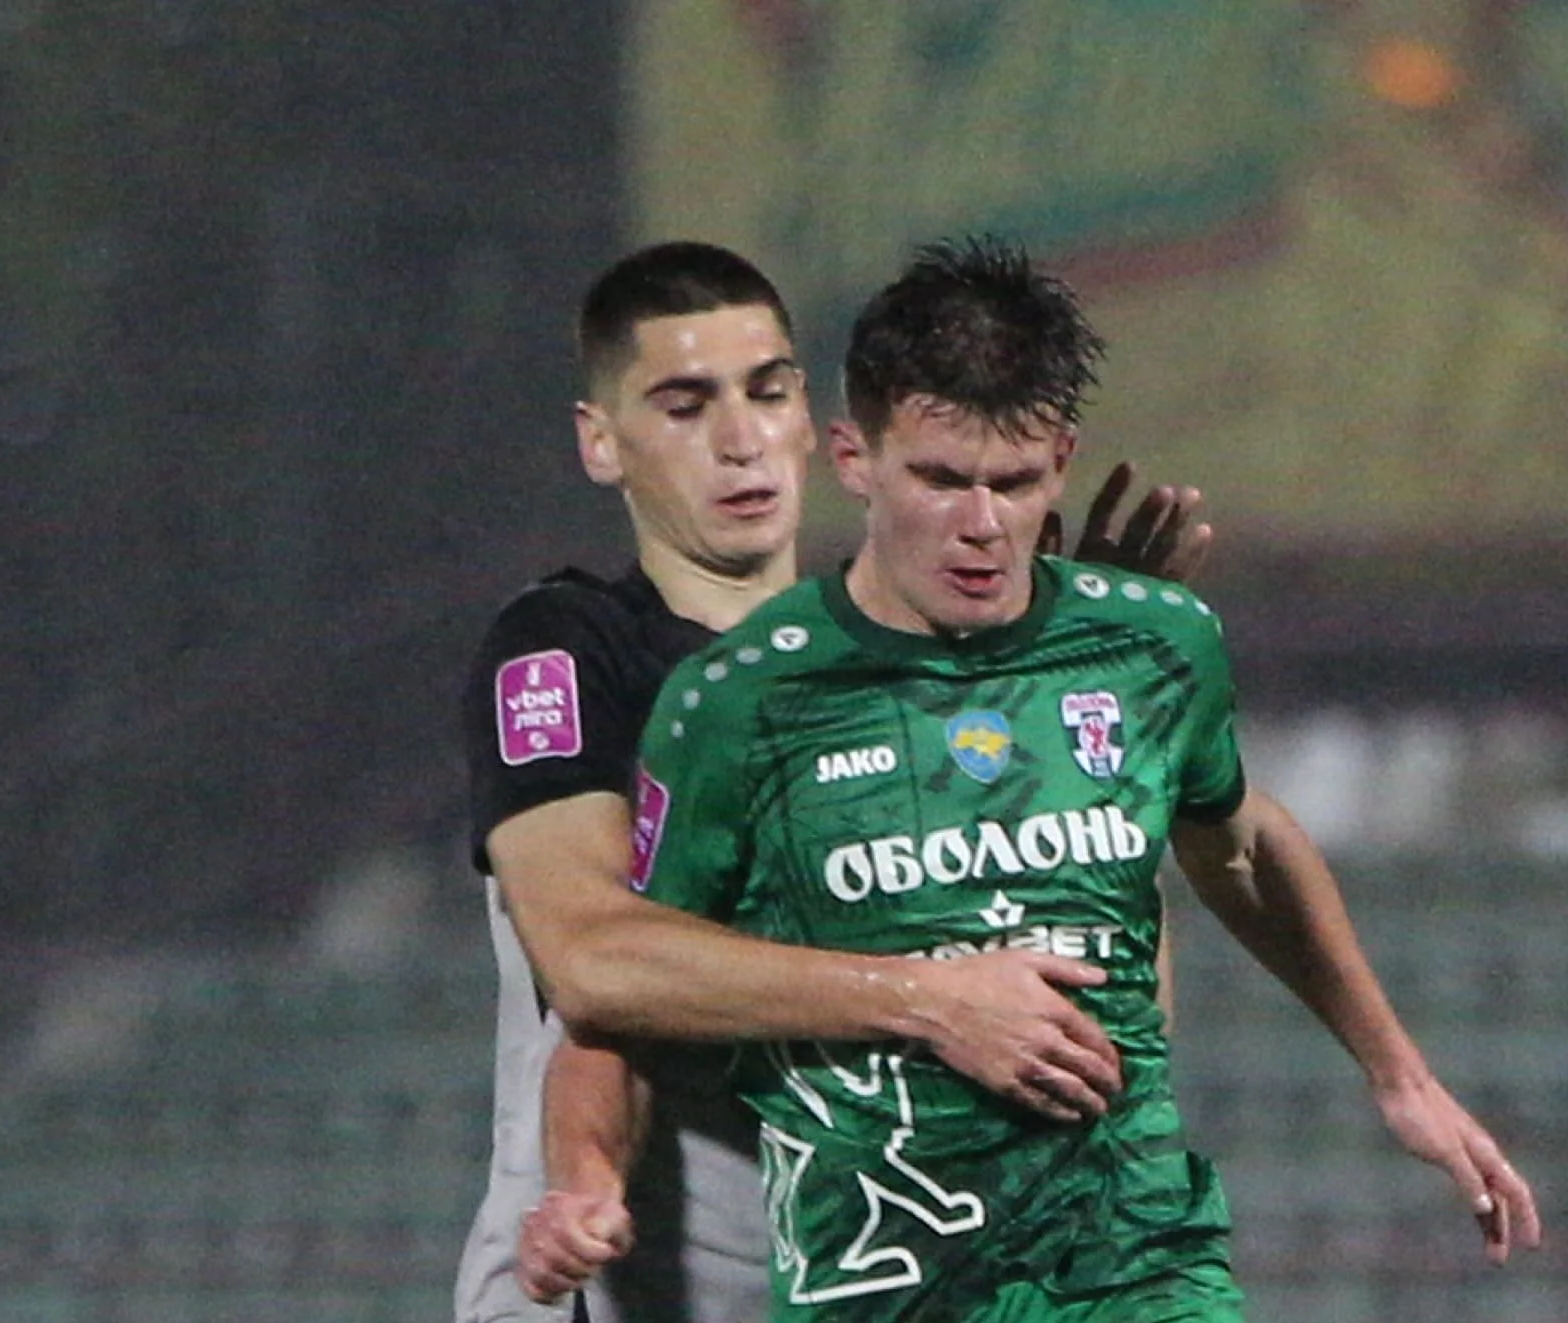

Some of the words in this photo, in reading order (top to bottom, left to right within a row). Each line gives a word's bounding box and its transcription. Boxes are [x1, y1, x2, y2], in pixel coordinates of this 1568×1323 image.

[505, 687, 565, 711] vbet
[817, 746, 897, 783] JAKO
[824, 805, 1147, 902] ОБОЛОНЬ
